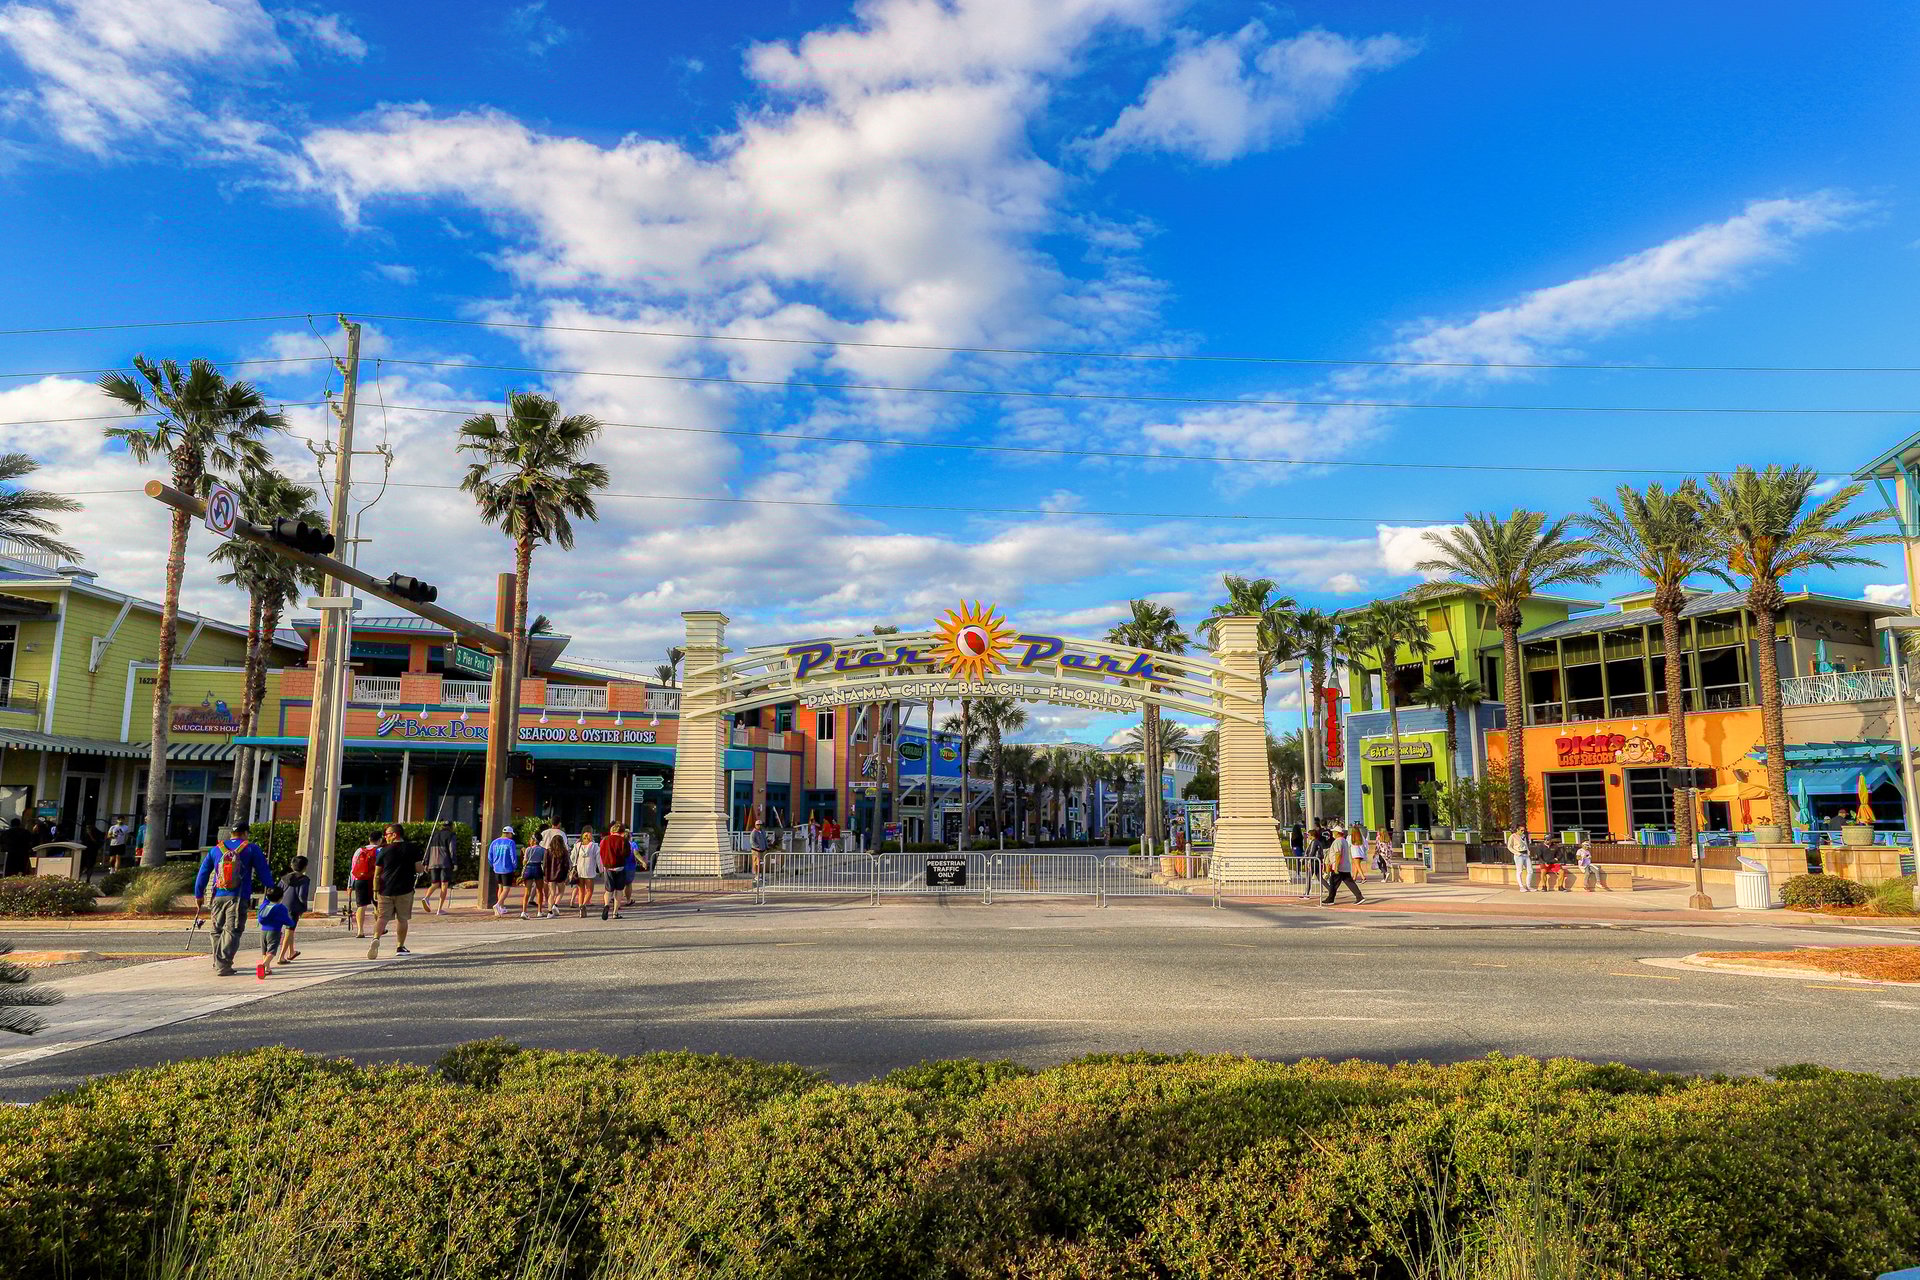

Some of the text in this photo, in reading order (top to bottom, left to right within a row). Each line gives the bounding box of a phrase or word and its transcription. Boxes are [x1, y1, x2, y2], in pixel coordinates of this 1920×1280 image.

[457, 649, 461, 662] S
[463, 652, 473, 666] Pier
[475, 655, 485, 670] Park
[784, 633, 1173, 682] Pier Park
[807, 682, 1136, 711] PANAMA CITY BEACH FLORIDA
[172, 724, 219, 732] SMUGGLER'S
[405, 719, 448, 738] BACK
[449, 720, 488, 741] PORC
[519, 727, 656, 743] SEAFOOD & OYSTER HOUSE
[1370, 746, 1387, 758] EAT
[1556, 733, 1625, 754] DICK'S
[1558, 753, 1616, 767] LAST RESORT
